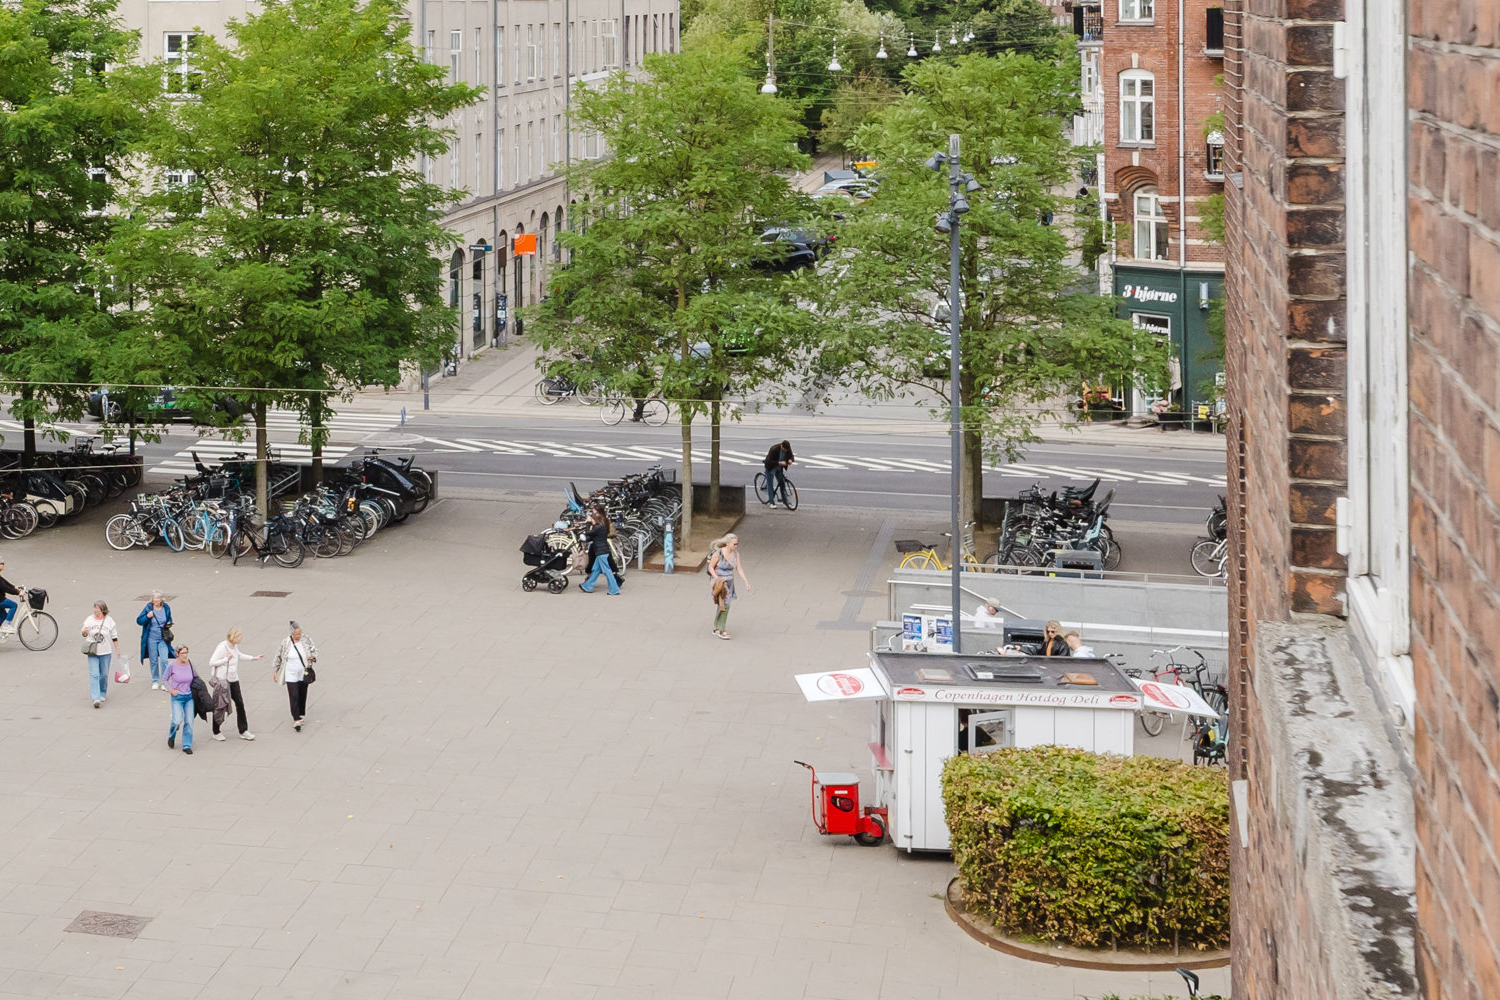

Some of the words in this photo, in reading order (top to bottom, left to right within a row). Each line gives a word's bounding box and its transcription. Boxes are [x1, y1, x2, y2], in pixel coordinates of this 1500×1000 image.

[1134, 286, 1177, 302] bjørne
[934, 689, 1014, 703] Copenhagen
[1017, 692, 1067, 705] Hotdog
[1071, 694, 1100, 705] Deli
